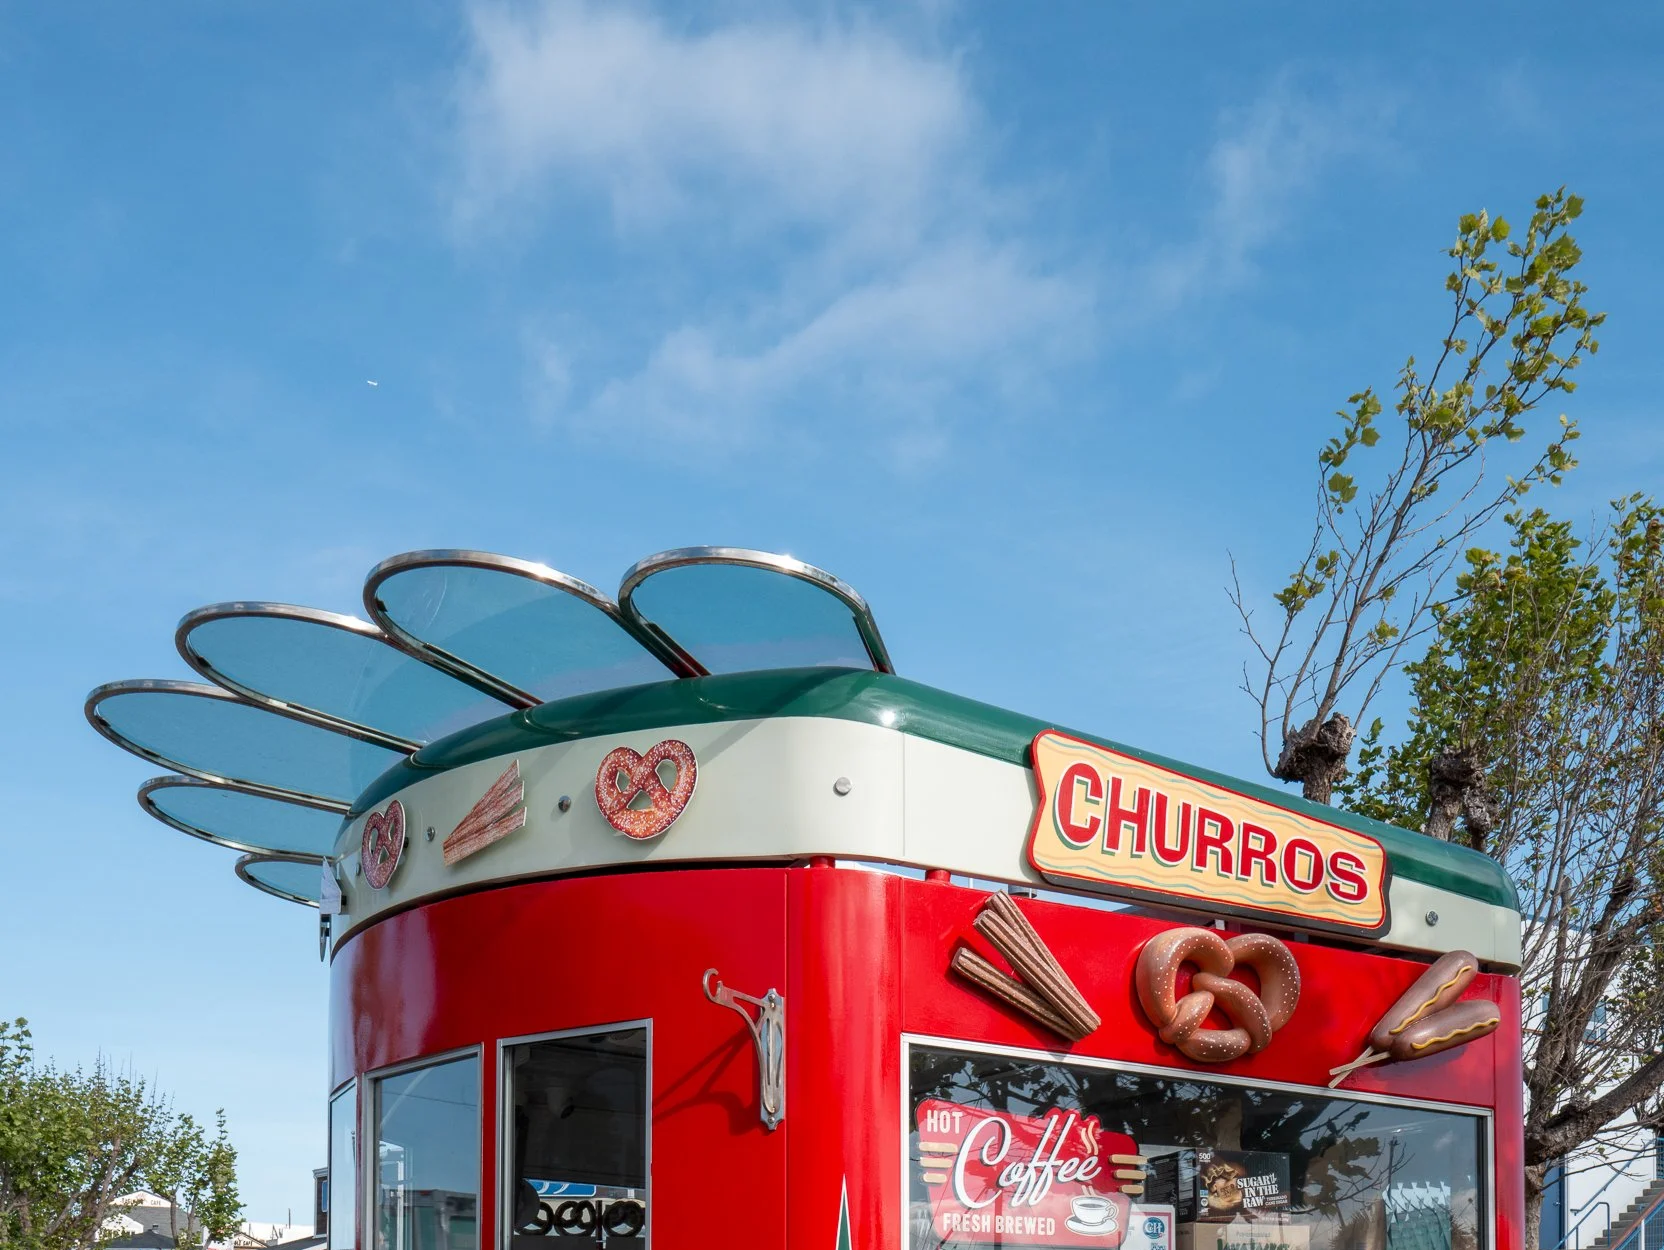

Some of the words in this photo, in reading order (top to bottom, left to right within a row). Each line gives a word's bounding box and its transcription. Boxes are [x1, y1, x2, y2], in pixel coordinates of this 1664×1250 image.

[1053, 761, 1368, 905] CHURROS
[926, 1110, 963, 1134] HOT
[955, 1113, 1102, 1209] Coffee
[1199, 1152, 1211, 1160] 500
[1237, 1175, 1270, 1188] SUGAR
[1244, 1187, 1256, 1198] IN
[1258, 1185, 1279, 1195] THE
[1243, 1196, 1264, 1208] RAW
[943, 1213, 990, 1232] FRESH
[995, 1215, 1055, 1235] BREWED
